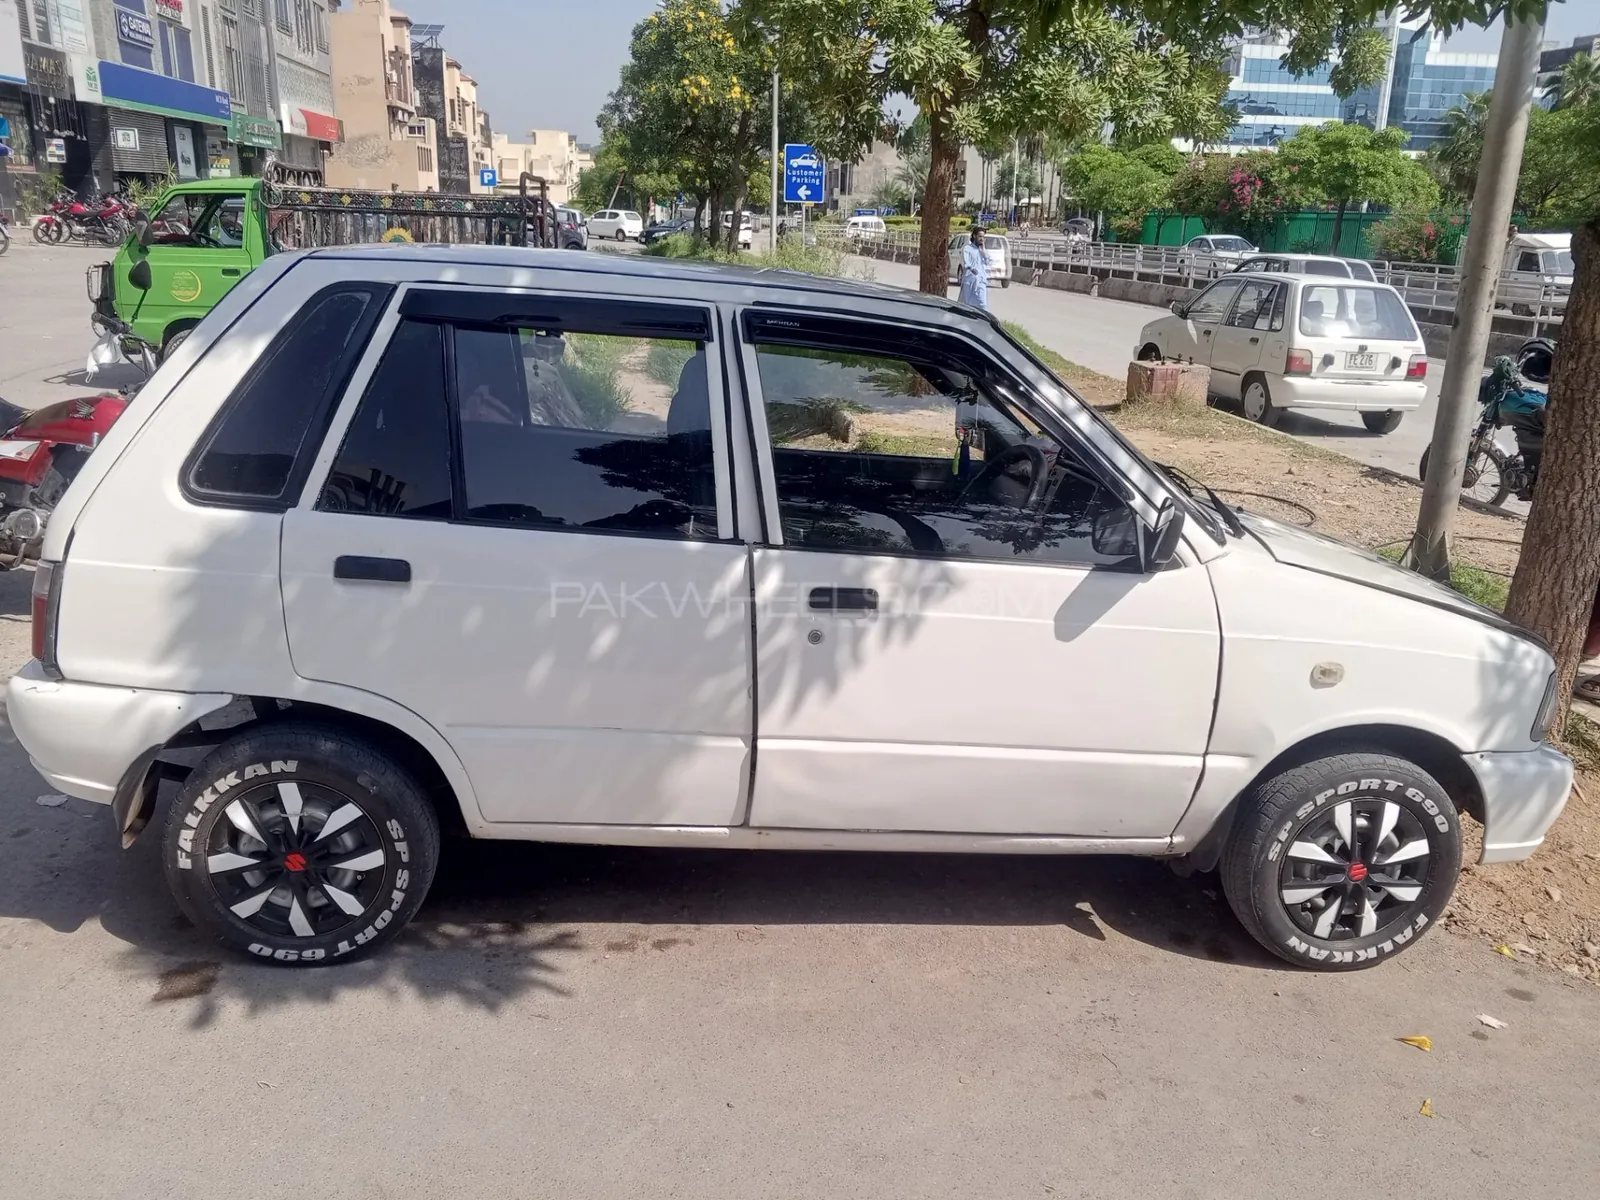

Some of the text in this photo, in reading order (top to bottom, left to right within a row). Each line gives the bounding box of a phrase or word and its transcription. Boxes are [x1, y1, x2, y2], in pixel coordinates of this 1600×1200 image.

[483, 172, 493, 183] P
[792, 177, 820, 185] Parking
[177, 760, 298, 869] FALKKAN
[1268, 778, 1449, 862] SP SPORT 690
[248, 818, 409, 961] SP SPORT 690
[1285, 913, 1429, 963] FALKKAN
